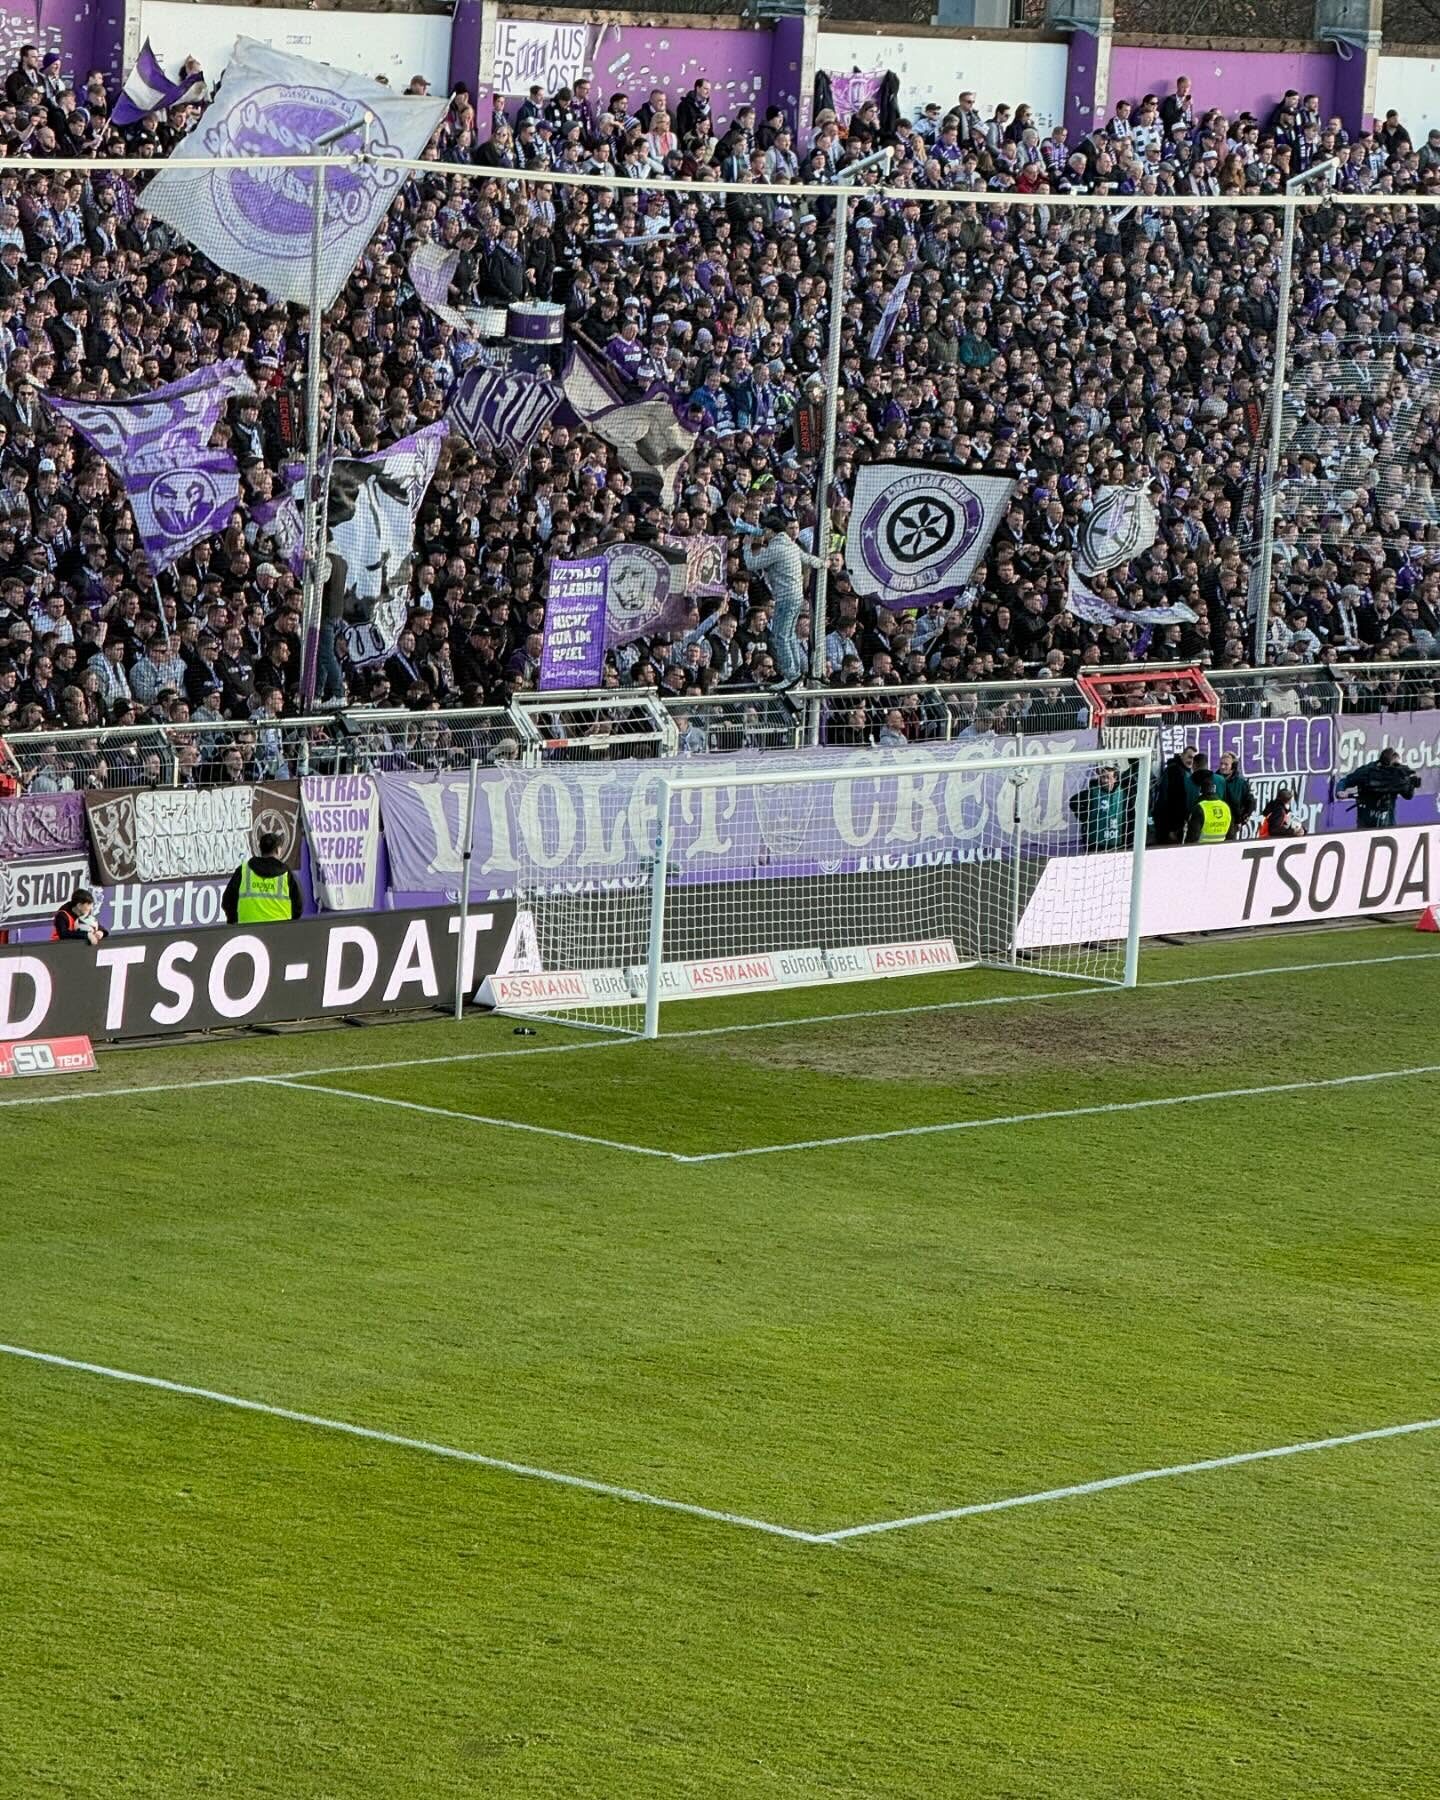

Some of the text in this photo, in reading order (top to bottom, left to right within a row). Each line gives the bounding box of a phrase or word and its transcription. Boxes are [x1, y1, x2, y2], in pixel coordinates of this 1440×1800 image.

[550, 28, 584, 60] AUS
[303, 775, 371, 802] ULTRAS
[309, 808, 369, 833] PASSION
[16, 869, 83, 907] STADT
[1241, 832, 1440, 920] TSO DA
[96, 911, 543, 1030] TSO-DATA
[500, 977, 581, 998] ASSMANN
[592, 971, 680, 994] BÜROMBEL
[692, 960, 770, 985] ASSMANN
[876, 946, 951, 969] ASSMANN
[57, 1053, 88, 1068] TECH
